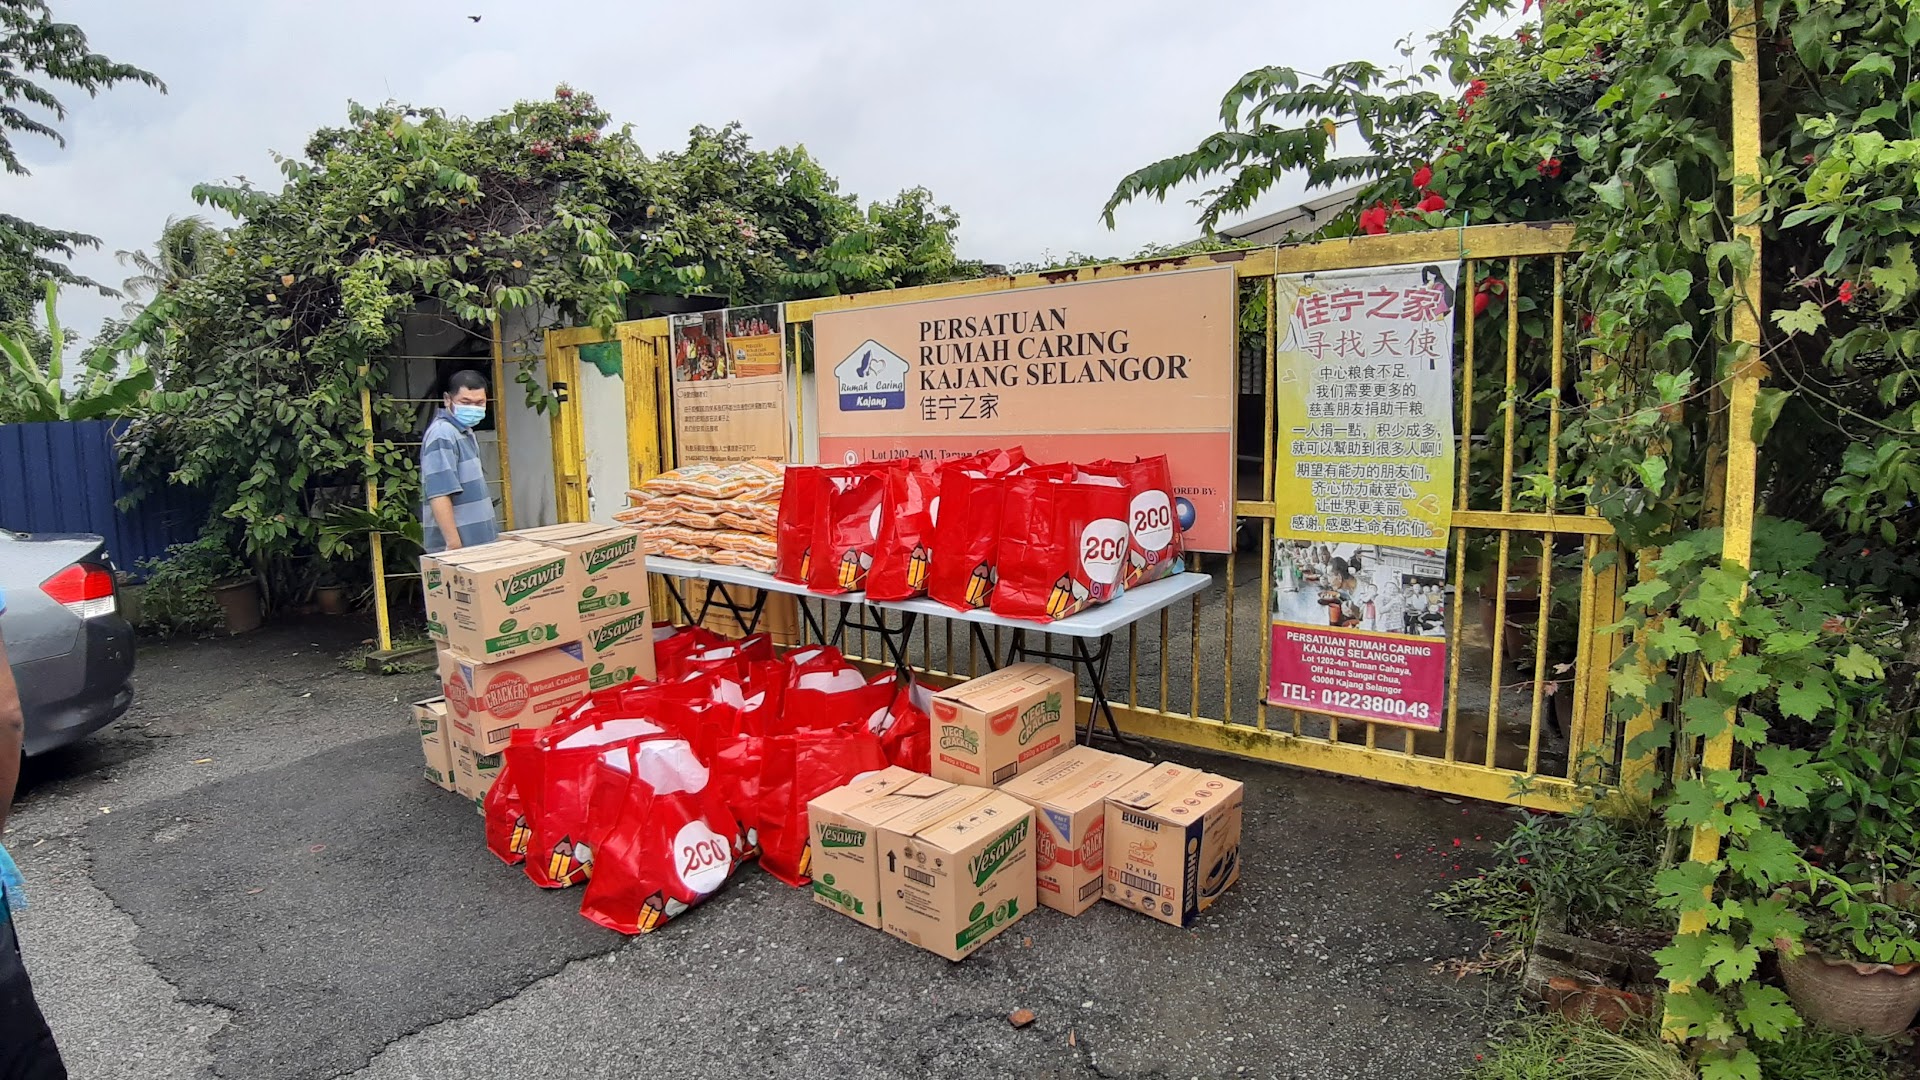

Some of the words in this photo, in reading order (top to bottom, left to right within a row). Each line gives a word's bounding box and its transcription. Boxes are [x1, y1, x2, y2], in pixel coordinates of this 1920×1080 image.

[1295, 285, 1442, 330] 佳宁之家
[919, 307, 1068, 342] PERSATUAN
[919, 339, 1014, 367] RUMAH
[1017, 329, 1129, 359] CARING
[1301, 328, 1441, 360] 寻找天使
[919, 364, 1019, 391] KAJANG
[1026, 354, 1189, 386] SELANGOR
[841, 382, 868, 392] Rumah
[875, 380, 903, 392] Caring
[1316, 382, 1417, 399] 我们需要更多的
[856, 396, 887, 408] Kajang
[919, 393, 999, 421] 佳宁之家
[872, 449, 887, 460] Lot
[1174, 487, 1199, 495] ORED
[1202, 487, 1217, 496] BY:
[580, 538, 635, 572] Vesawit
[495, 561, 564, 602] Vesawit
[588, 615, 643, 649] Vesawit
[1286, 631, 1346, 647] PERSATUAN
[1348, 638, 1387, 652] RUMAH
[1389, 643, 1431, 657] CARING
[1301, 654, 1315, 664] Lot
[1316, 655, 1350, 668] 1202-4m
[1350, 660, 1377, 671] Taman
[1378, 664, 1412, 676] Cahaya,
[1303, 643, 1345, 657] KAJANG
[1347, 649, 1408, 666] SELANGOR,
[532, 680, 556, 693] Wheat
[556, 674, 581, 686] Cracker
[1310, 664, 1323, 674] Off
[1324, 666, 1346, 677] Jalan
[1347, 669, 1376, 683] Sungai
[1377, 674, 1401, 685] Chua,
[1311, 675, 1335, 686] 43000
[1335, 679, 1364, 692] Kajang
[1365, 682, 1403, 695] Selangor
[484, 682, 529, 709] CRACKERS
[1280, 682, 1316, 702] TEL:
[1321, 688, 1430, 719] 0122380043
[1021, 701, 1047, 726] VEGE
[942, 725, 965, 738] VEGE
[1019, 710, 1060, 745] CRACKERS
[940, 736, 978, 754] CRACKERS
[816, 821, 863, 846] Vesawit
[1121, 811, 1159, 832] BURUH
[968, 822, 1026, 885] Vesawit
[1081, 831, 1103, 861] CRACK
[1125, 862, 1134, 871] 12
[1184, 851, 1197, 913] BURUH
